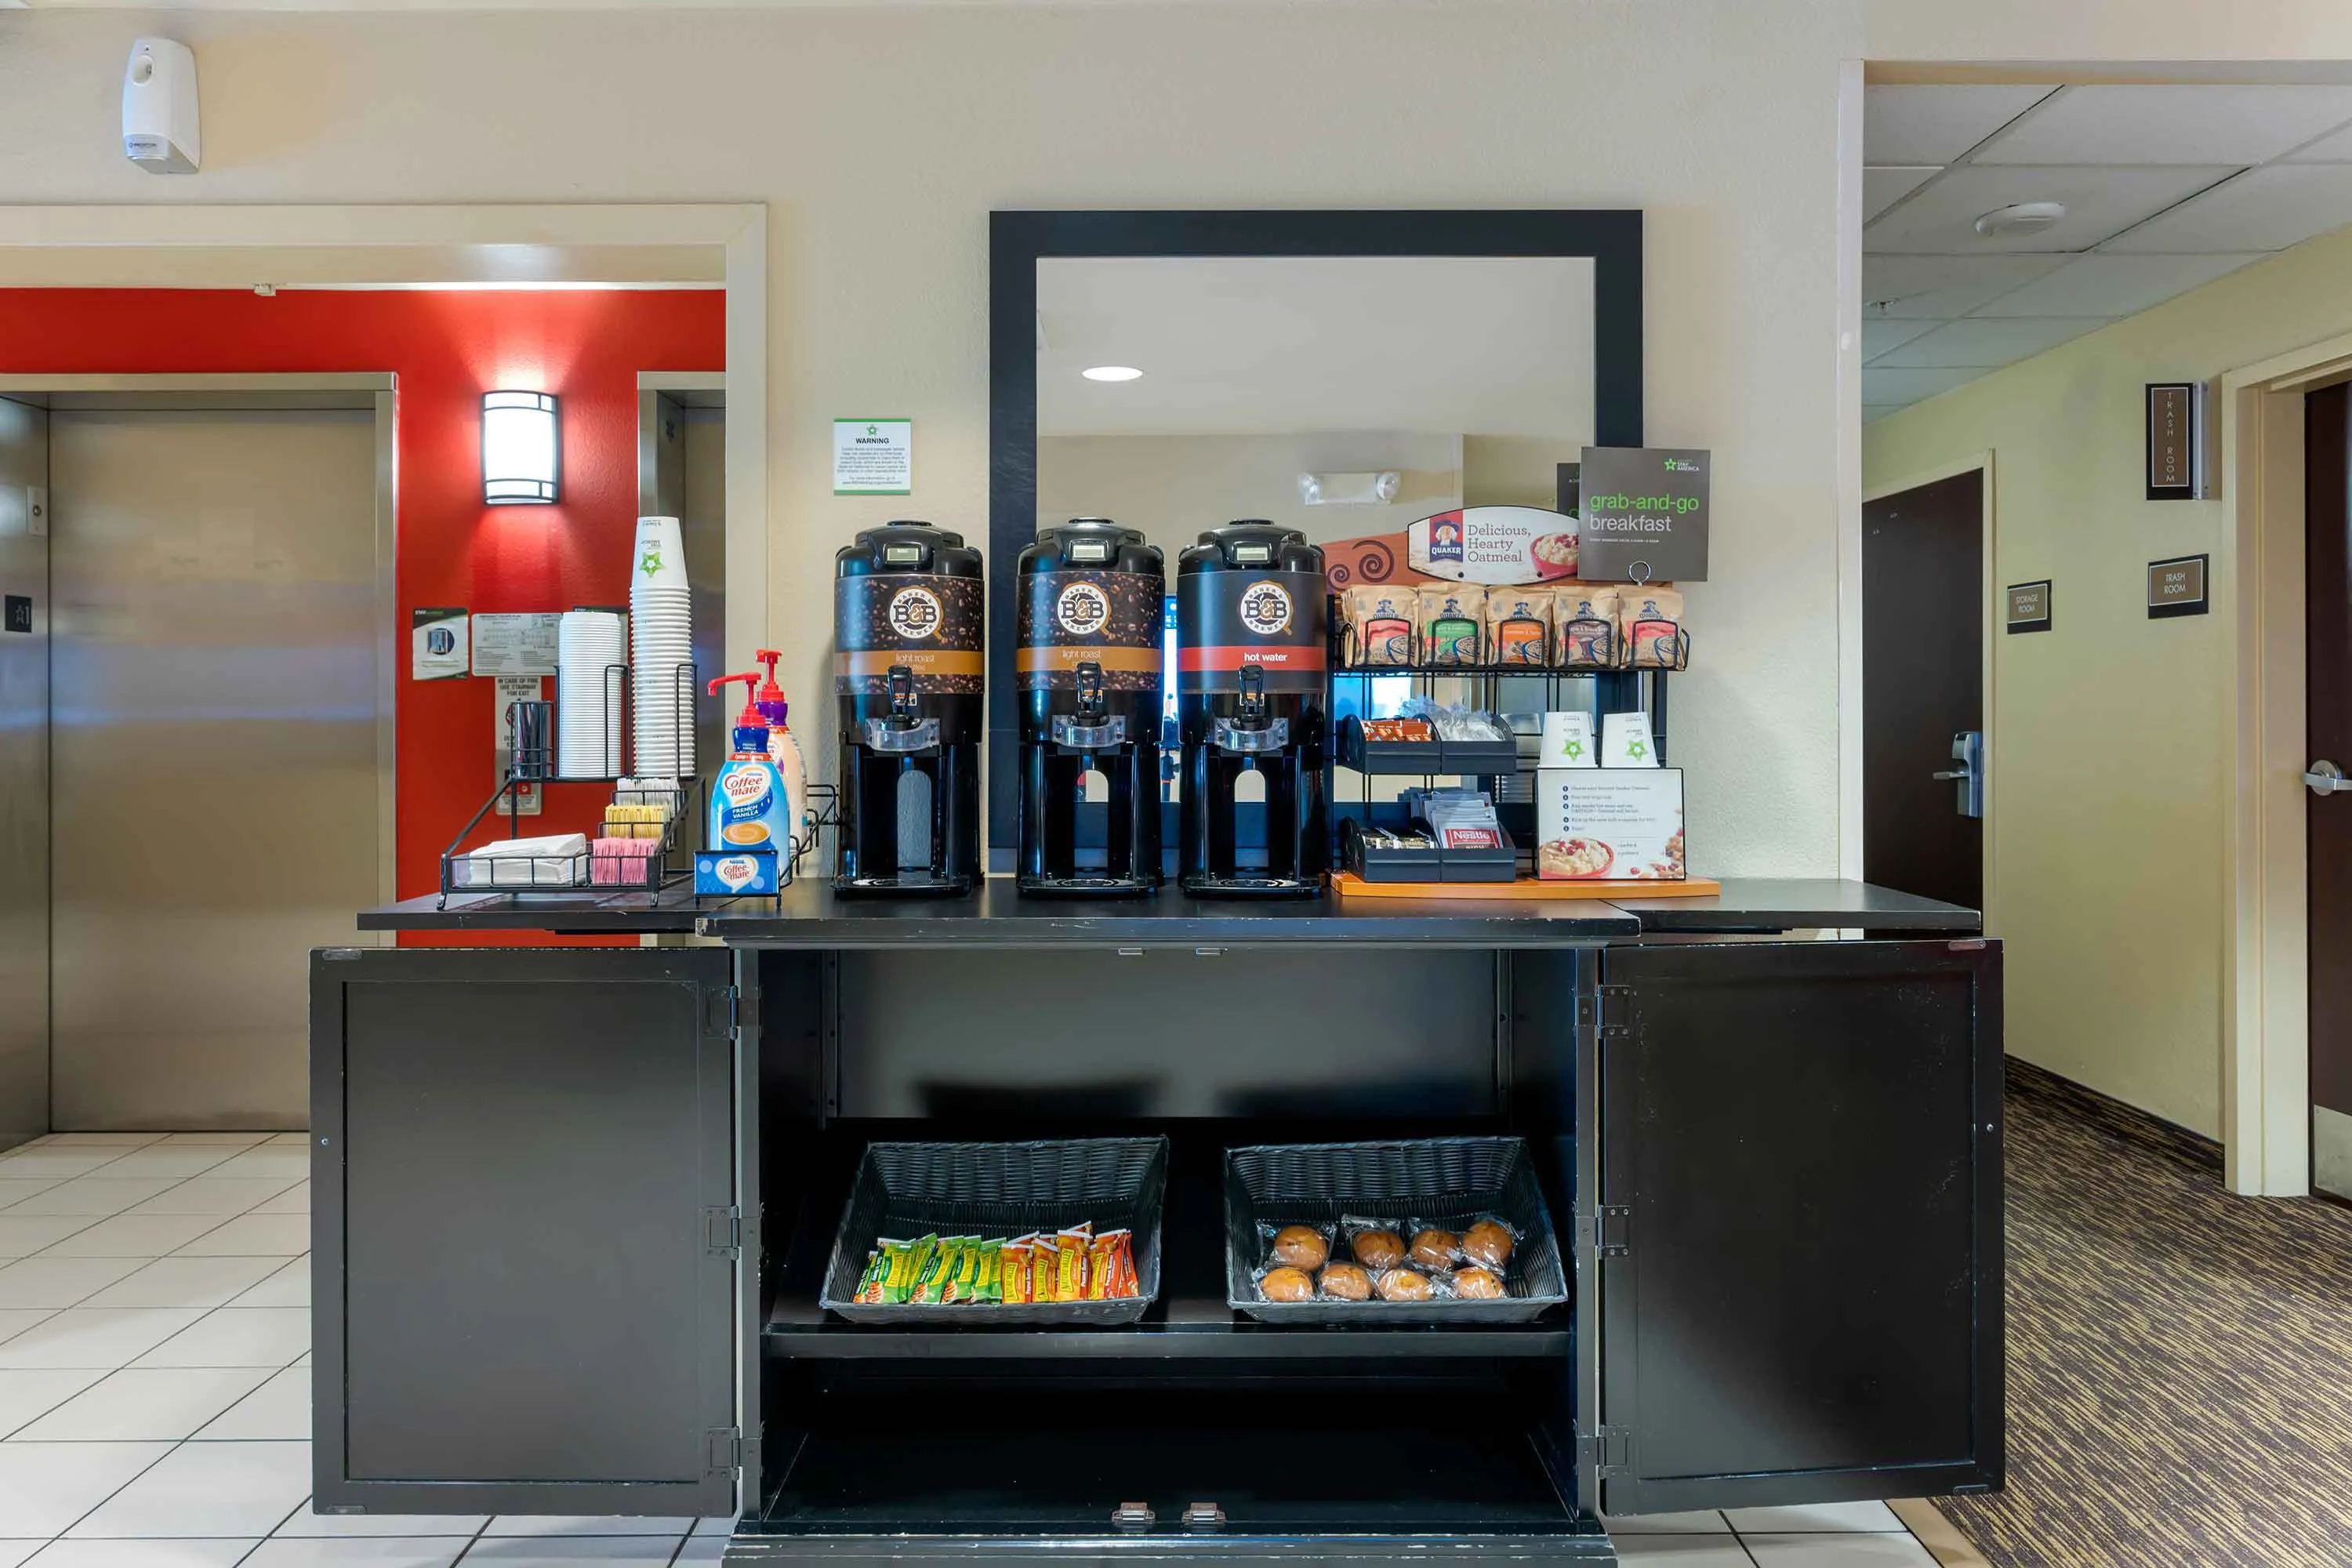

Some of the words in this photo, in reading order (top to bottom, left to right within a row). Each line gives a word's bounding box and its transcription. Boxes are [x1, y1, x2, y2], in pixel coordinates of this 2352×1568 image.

[2165, 446, 2176, 482] ROOM
[1589, 492, 1700, 514] grab-and-go
[1590, 514, 1671, 532] breakfast
[1468, 523, 1531, 537] Delicious,
[1431, 546, 1461, 556] QUAKER
[1468, 538, 1513, 551] Hearty
[1468, 550, 1522, 563] Oatmeal
[2165, 572, 2186, 583] TRASH
[2164, 584, 2187, 595] ROOM
[893, 604, 937, 624] B&B
[1061, 600, 1105, 619] B&B
[1244, 600, 1287, 619] B&B
[895, 653, 913, 664] light
[914, 654, 935, 662] roast
[1062, 649, 1080, 660] light
[1080, 650, 1102, 659] roast
[1244, 652, 1259, 662] hot
[1261, 653, 1287, 662] water
[724, 775, 763, 790] Coffee
[731, 786, 760, 797] mate
[732, 804, 758, 813] FRENCH
[733, 809, 759, 818] VANILLA
